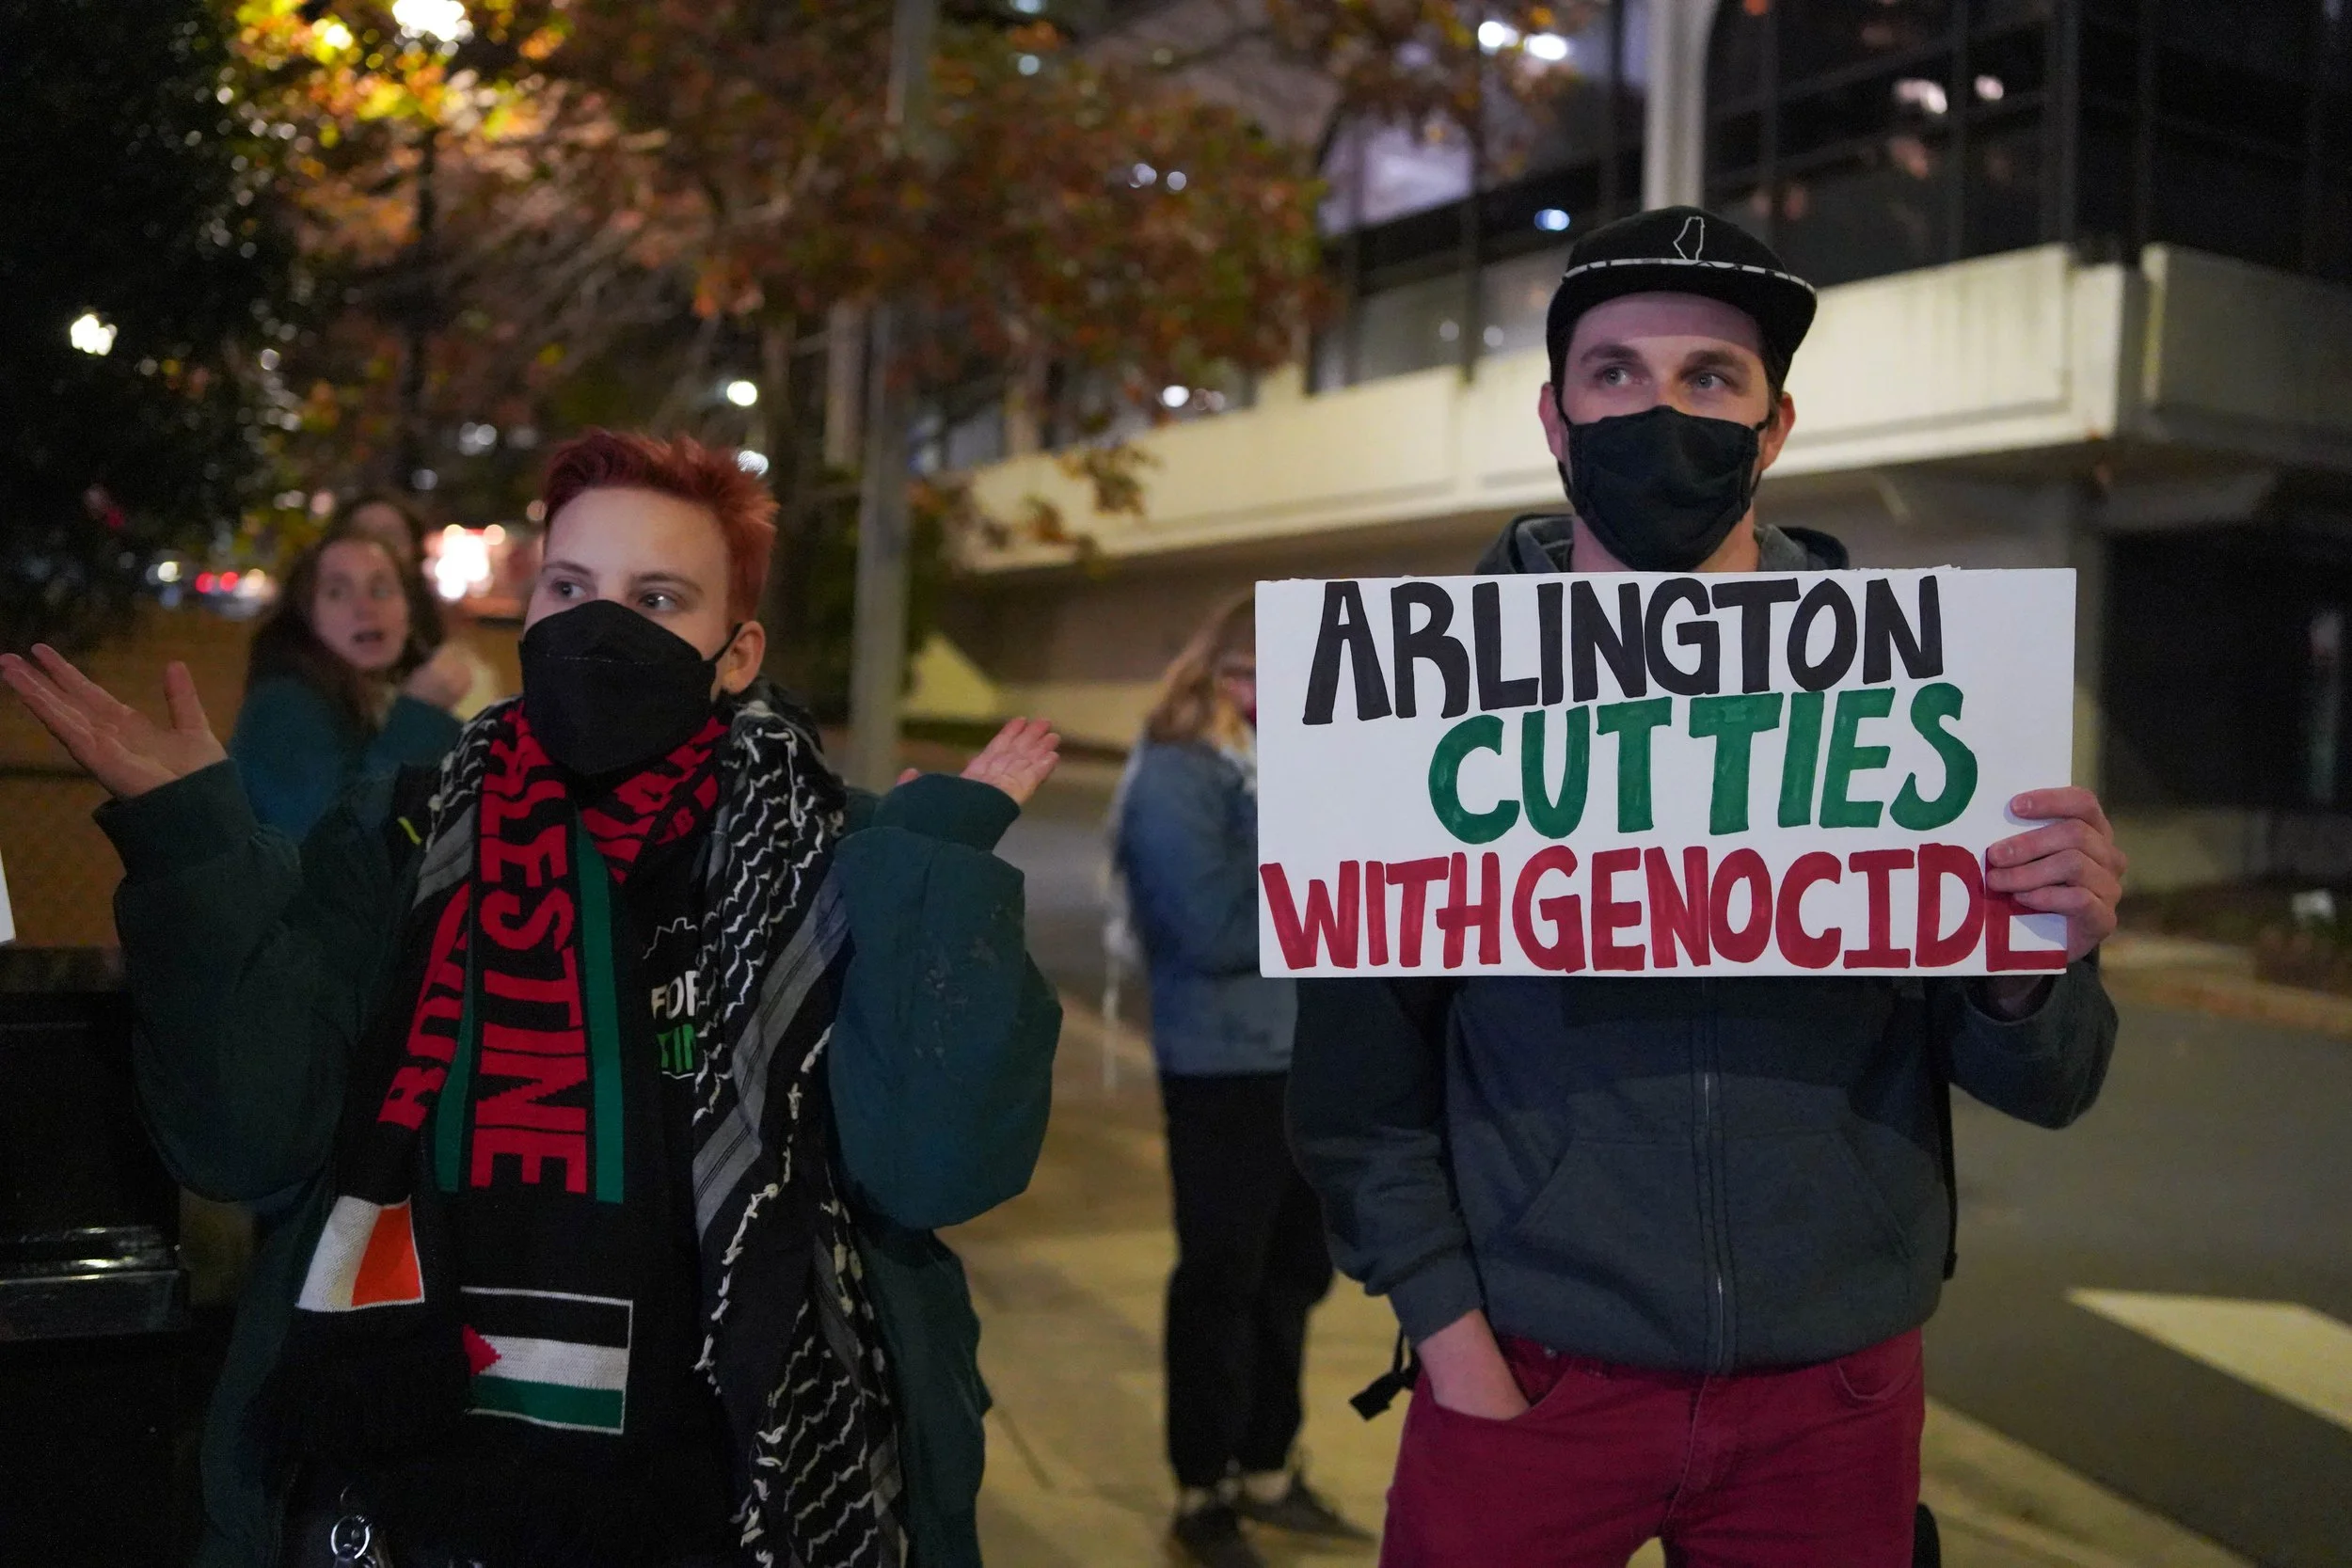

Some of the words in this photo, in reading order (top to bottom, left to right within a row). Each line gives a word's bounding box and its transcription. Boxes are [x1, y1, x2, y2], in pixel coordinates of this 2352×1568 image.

[1303, 576, 1943, 724] ARLINGTON
[1259, 852, 1502, 970] WITH
[1512, 843, 2067, 974] GENOCIDE
